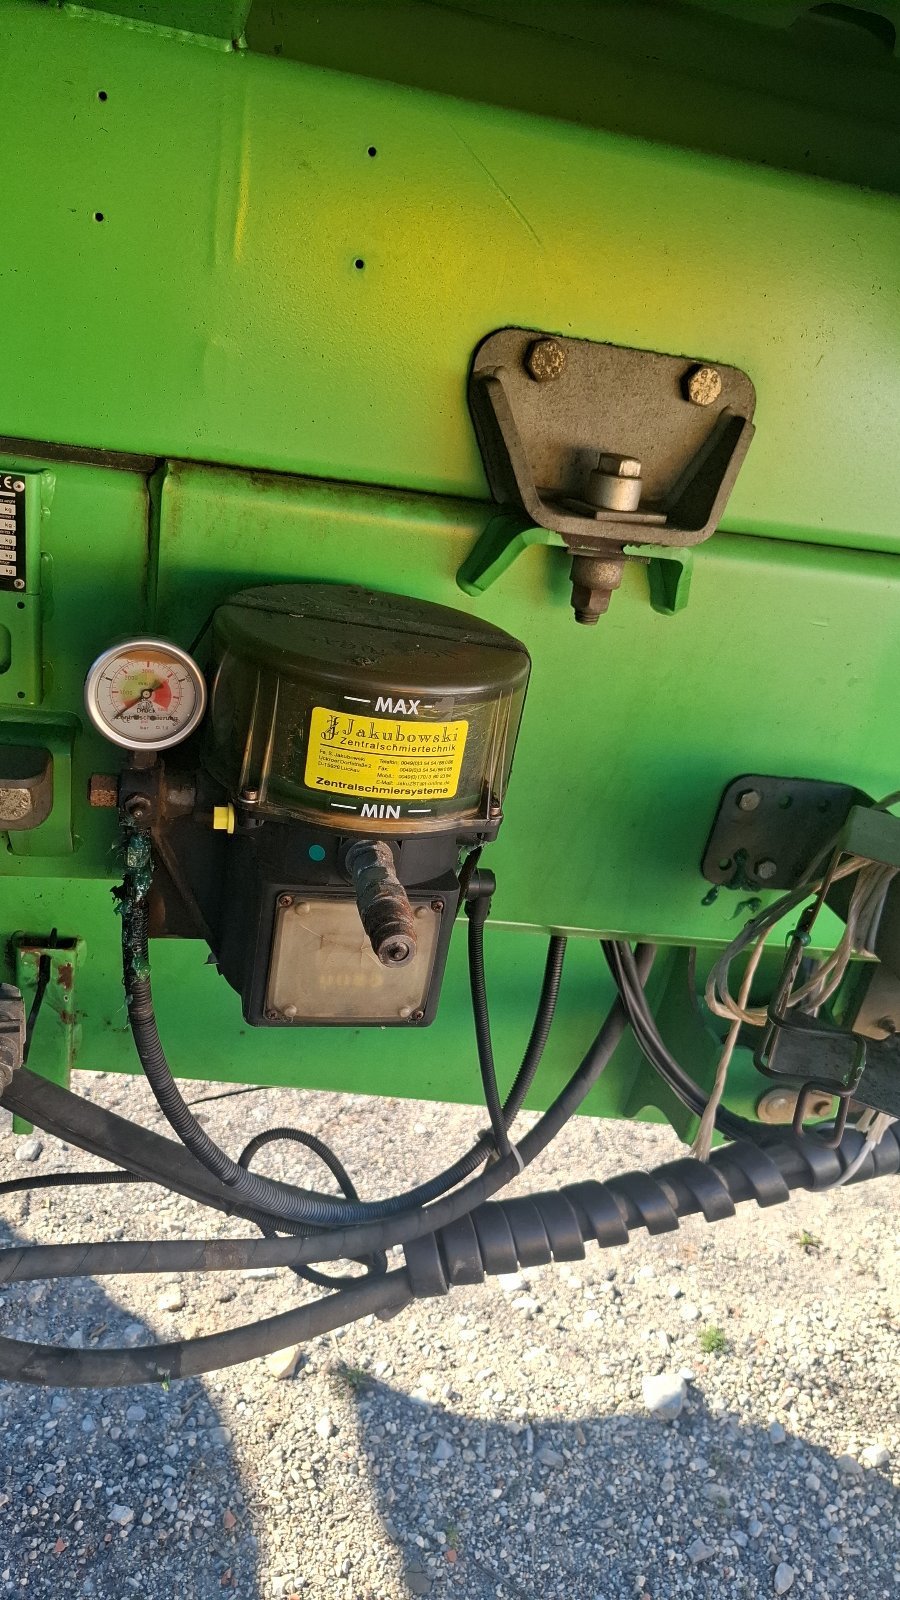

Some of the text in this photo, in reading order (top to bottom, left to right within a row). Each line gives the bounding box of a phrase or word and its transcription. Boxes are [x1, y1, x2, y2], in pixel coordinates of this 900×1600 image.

[374, 696, 421, 715] MAX
[342, 718, 459, 743] Jakubowski
[340, 736, 456, 753] Zentralschmiertechnik
[315, 776, 449, 797] Zentralschmiersysteme
[360, 803, 401, 820] MIN
